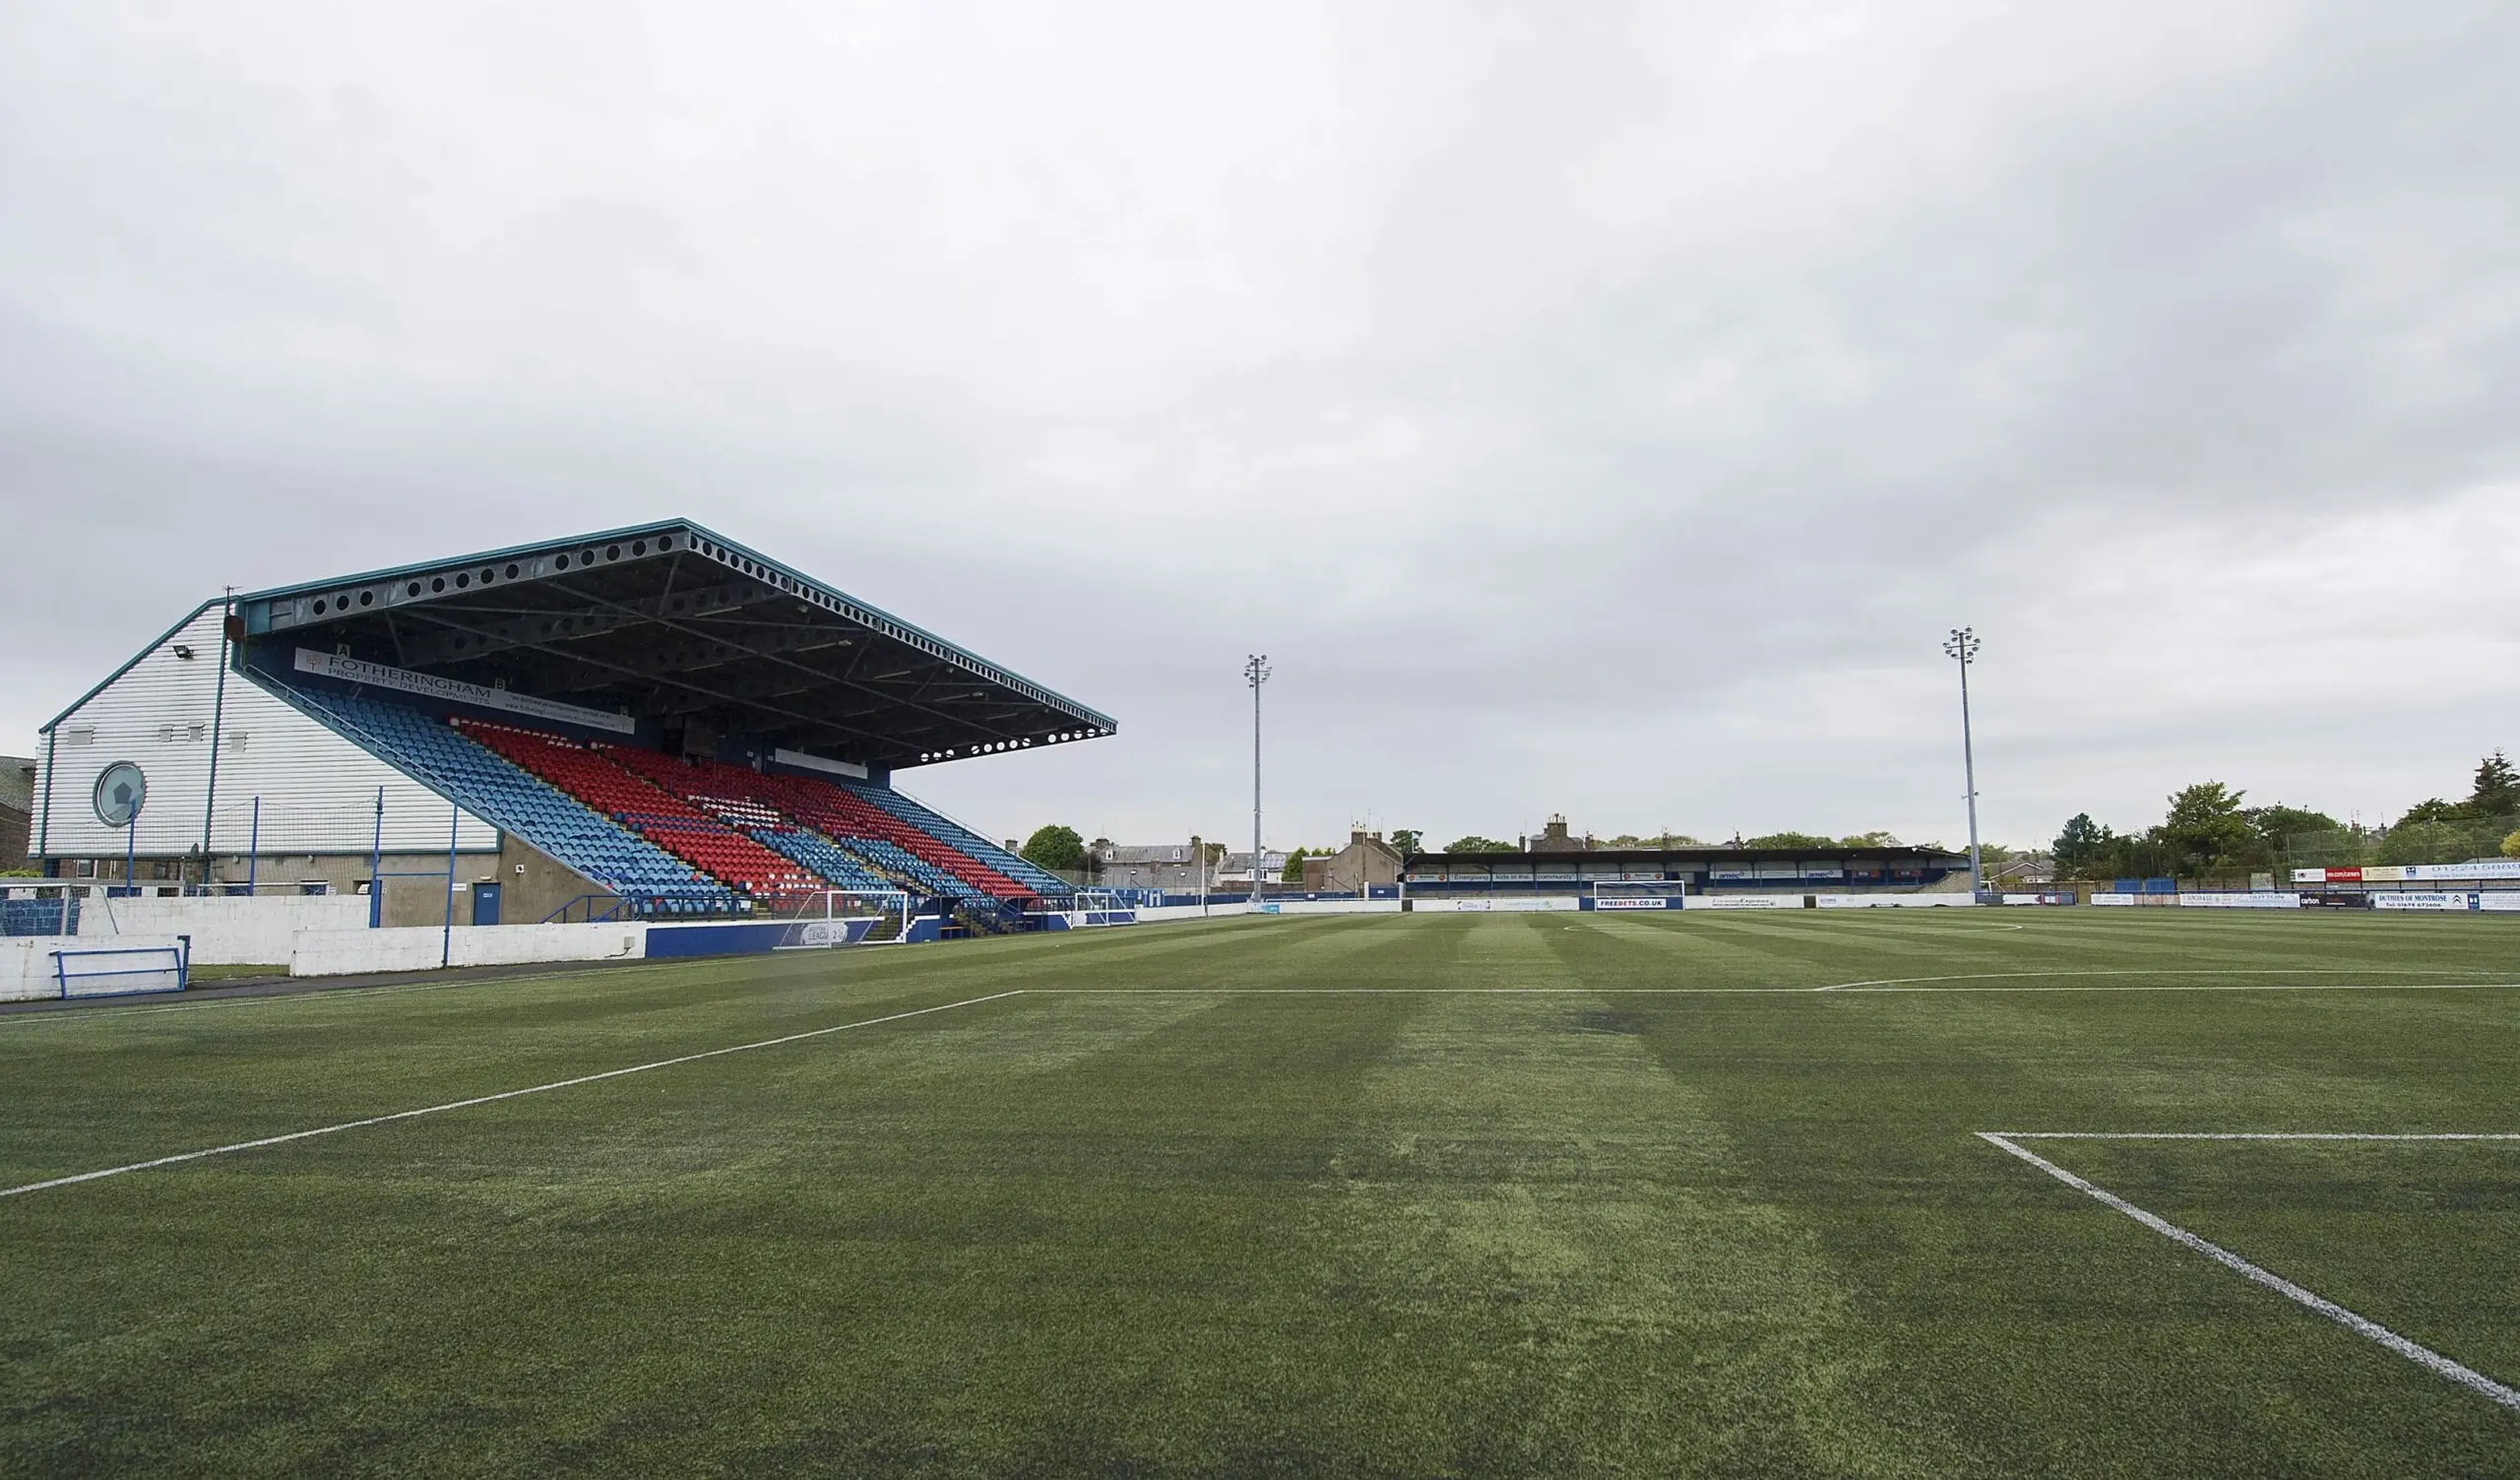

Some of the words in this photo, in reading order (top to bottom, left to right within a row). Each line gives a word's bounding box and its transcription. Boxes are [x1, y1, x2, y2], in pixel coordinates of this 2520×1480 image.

[339, 645, 348, 657] A
[328, 656, 491, 698] FOTHERINGHAM
[328, 668, 396, 688] PROPERTY
[398, 681, 491, 705] DEVELOPMENTS
[808, 931, 829, 940] LEAGU
